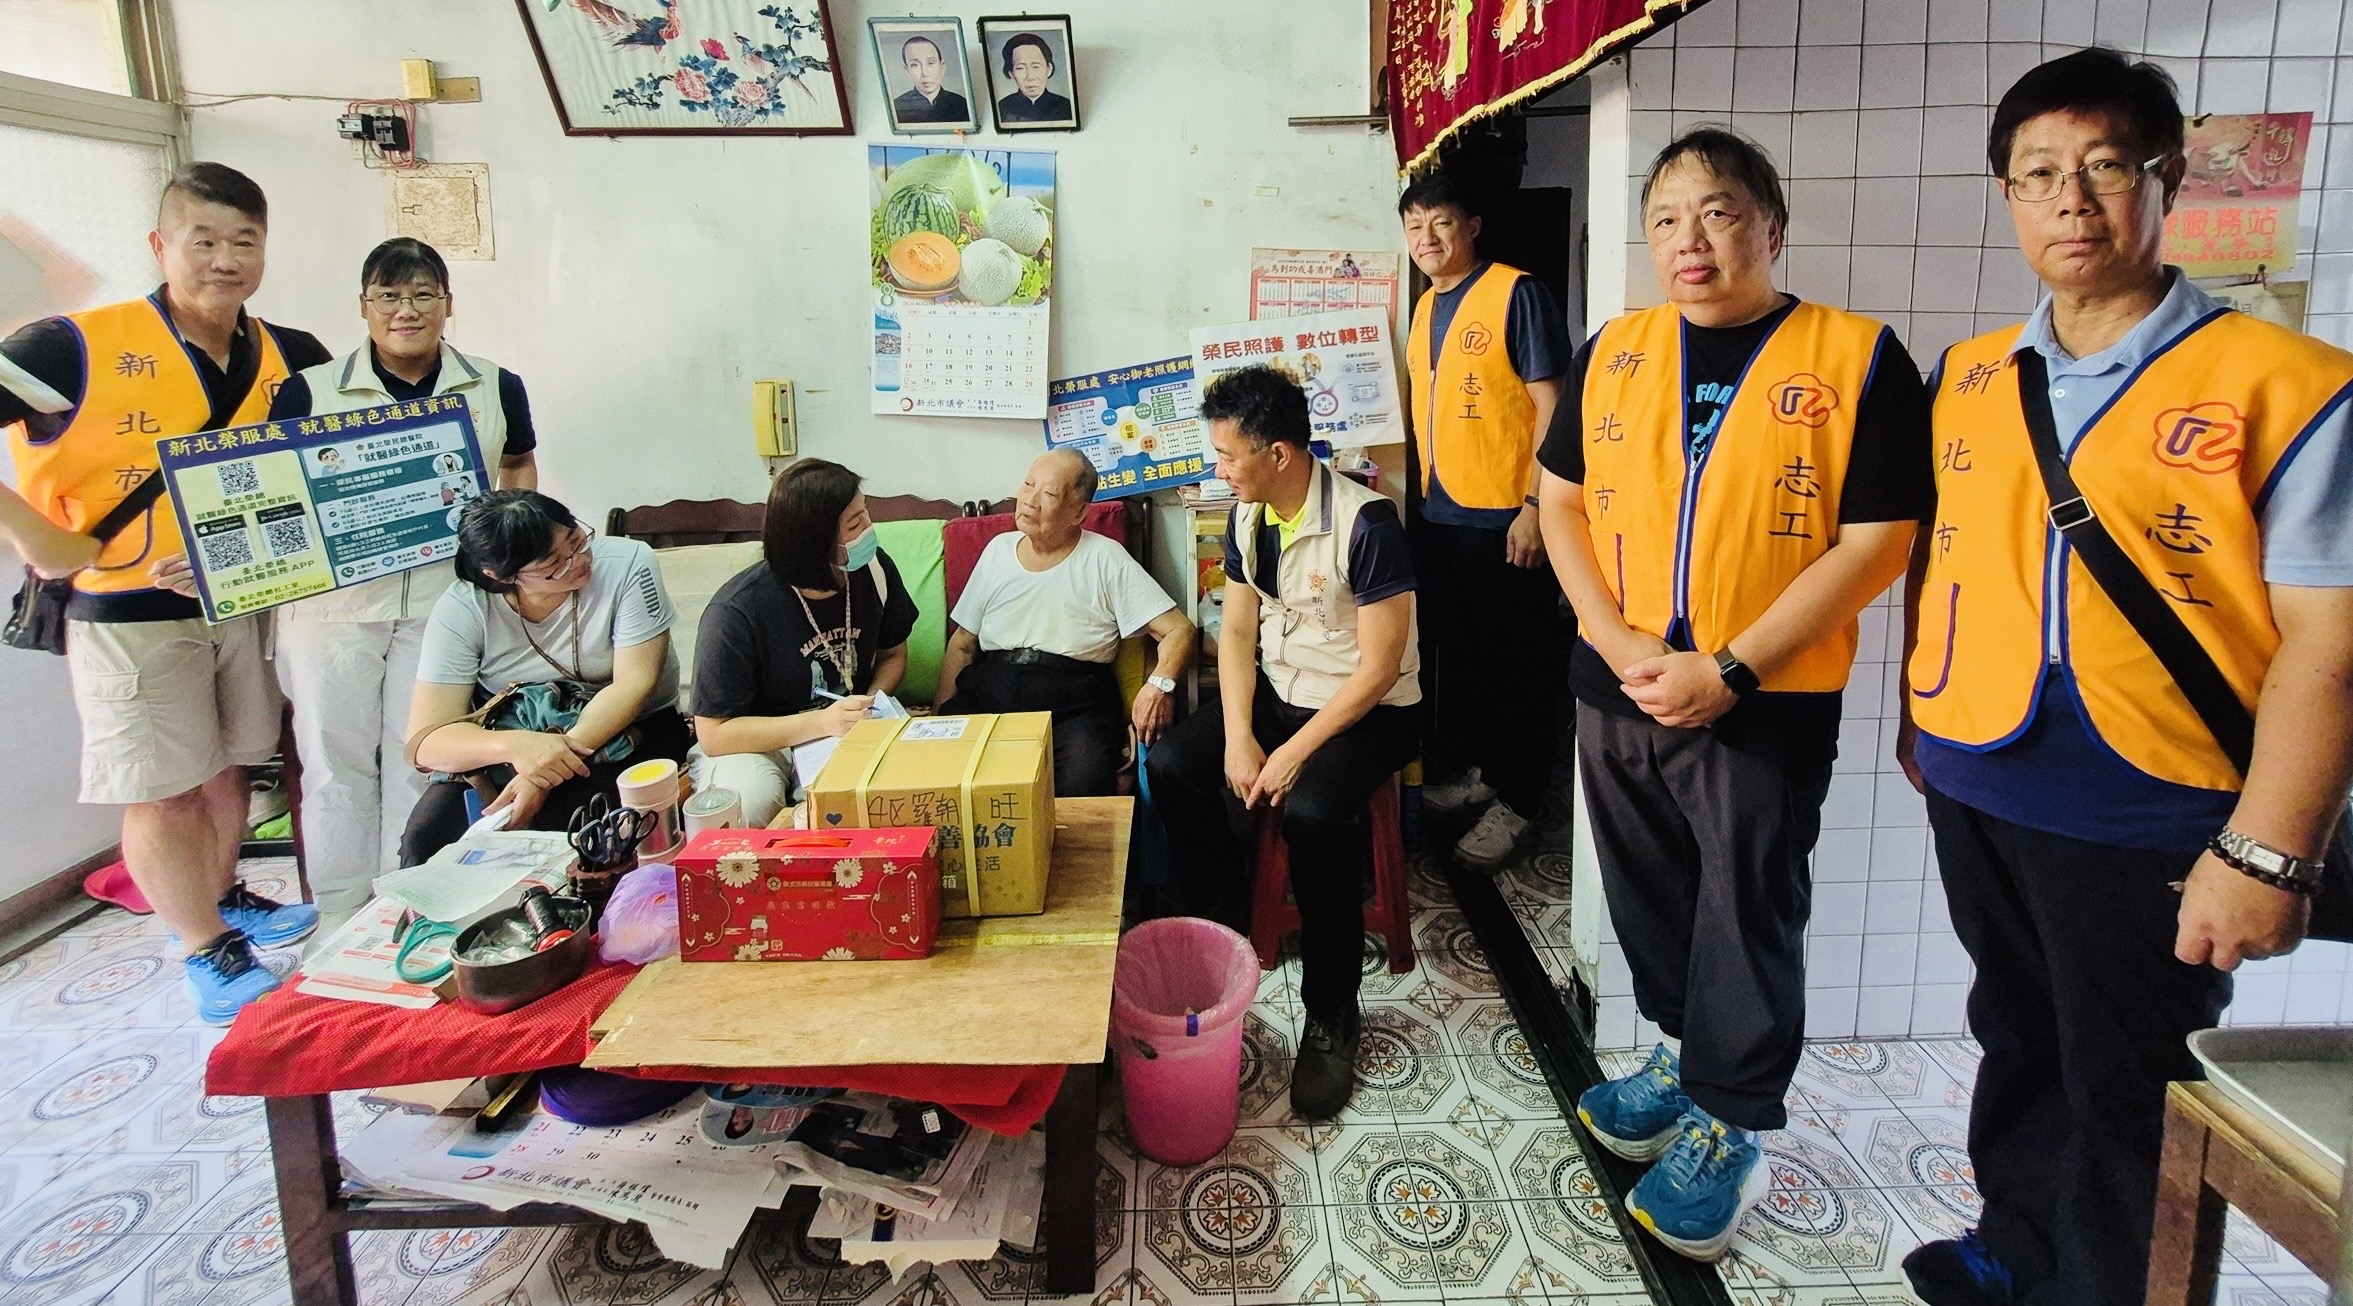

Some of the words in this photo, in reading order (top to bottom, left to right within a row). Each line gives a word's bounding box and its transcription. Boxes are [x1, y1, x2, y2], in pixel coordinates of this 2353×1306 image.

[880, 283, 895, 307] 8
[1202, 335, 1285, 362] 榮民照護
[1295, 325, 1380, 351] 數位轉型
[1052, 375, 1102, 395] 北榮服處
[1458, 372, 1483, 420] 志工
[916, 398, 964, 408] 新北市議會
[115, 351, 162, 491] 新北市
[167, 423, 289, 457] 新北榮服處
[297, 396, 463, 436] 就醫綠色通道資訊
[1593, 351, 1646, 520] 新北市
[1143, 457, 1203, 482] 全面應援
[1936, 360, 2001, 565] 新北市
[1768, 455, 1821, 540] 志工
[2146, 502, 2213, 609] 志工
[220, 566, 288, 590] 行動就醫服務
[291, 560, 315, 572] APP
[640, 567, 660, 616] PUMA
[947, 855, 1001, 872] 心活
[942, 875, 957, 889] 箱
[532, 1121, 551, 1133] 21
[568, 1125, 587, 1137] 22
[603, 1128, 622, 1139] 23
[638, 1131, 658, 1143] 24
[675, 1134, 694, 1146] 25
[510, 1143, 530, 1154] 28
[546, 1147, 565, 1158] 29
[581, 1151, 601, 1162] 30
[498, 1166, 592, 1191] 新北市議會
